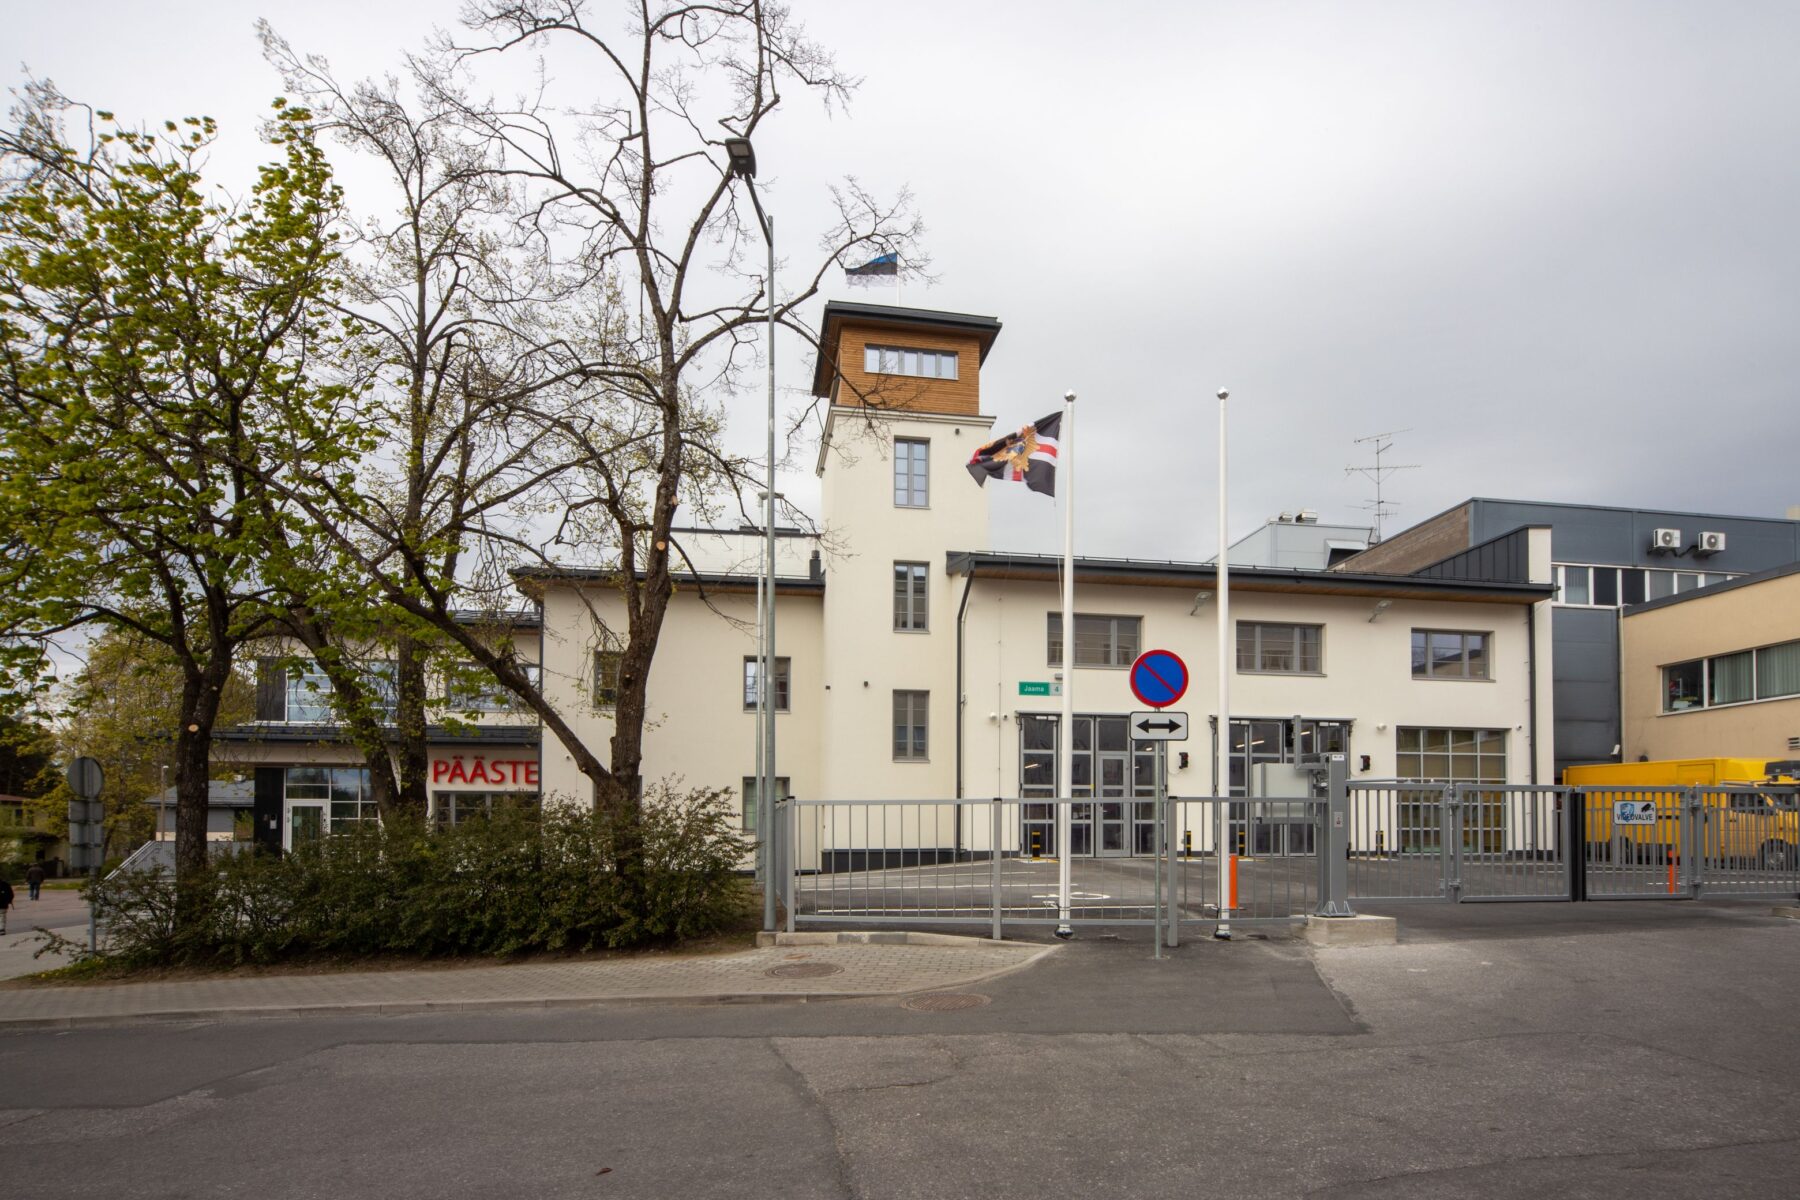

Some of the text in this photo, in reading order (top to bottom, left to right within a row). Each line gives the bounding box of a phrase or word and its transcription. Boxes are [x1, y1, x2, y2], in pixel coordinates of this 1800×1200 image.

[1024, 684, 1045, 692] Jaama
[433, 755, 538, 784] PÄÄSTE
[1616, 813, 1653, 821] VIDEOVALVE
